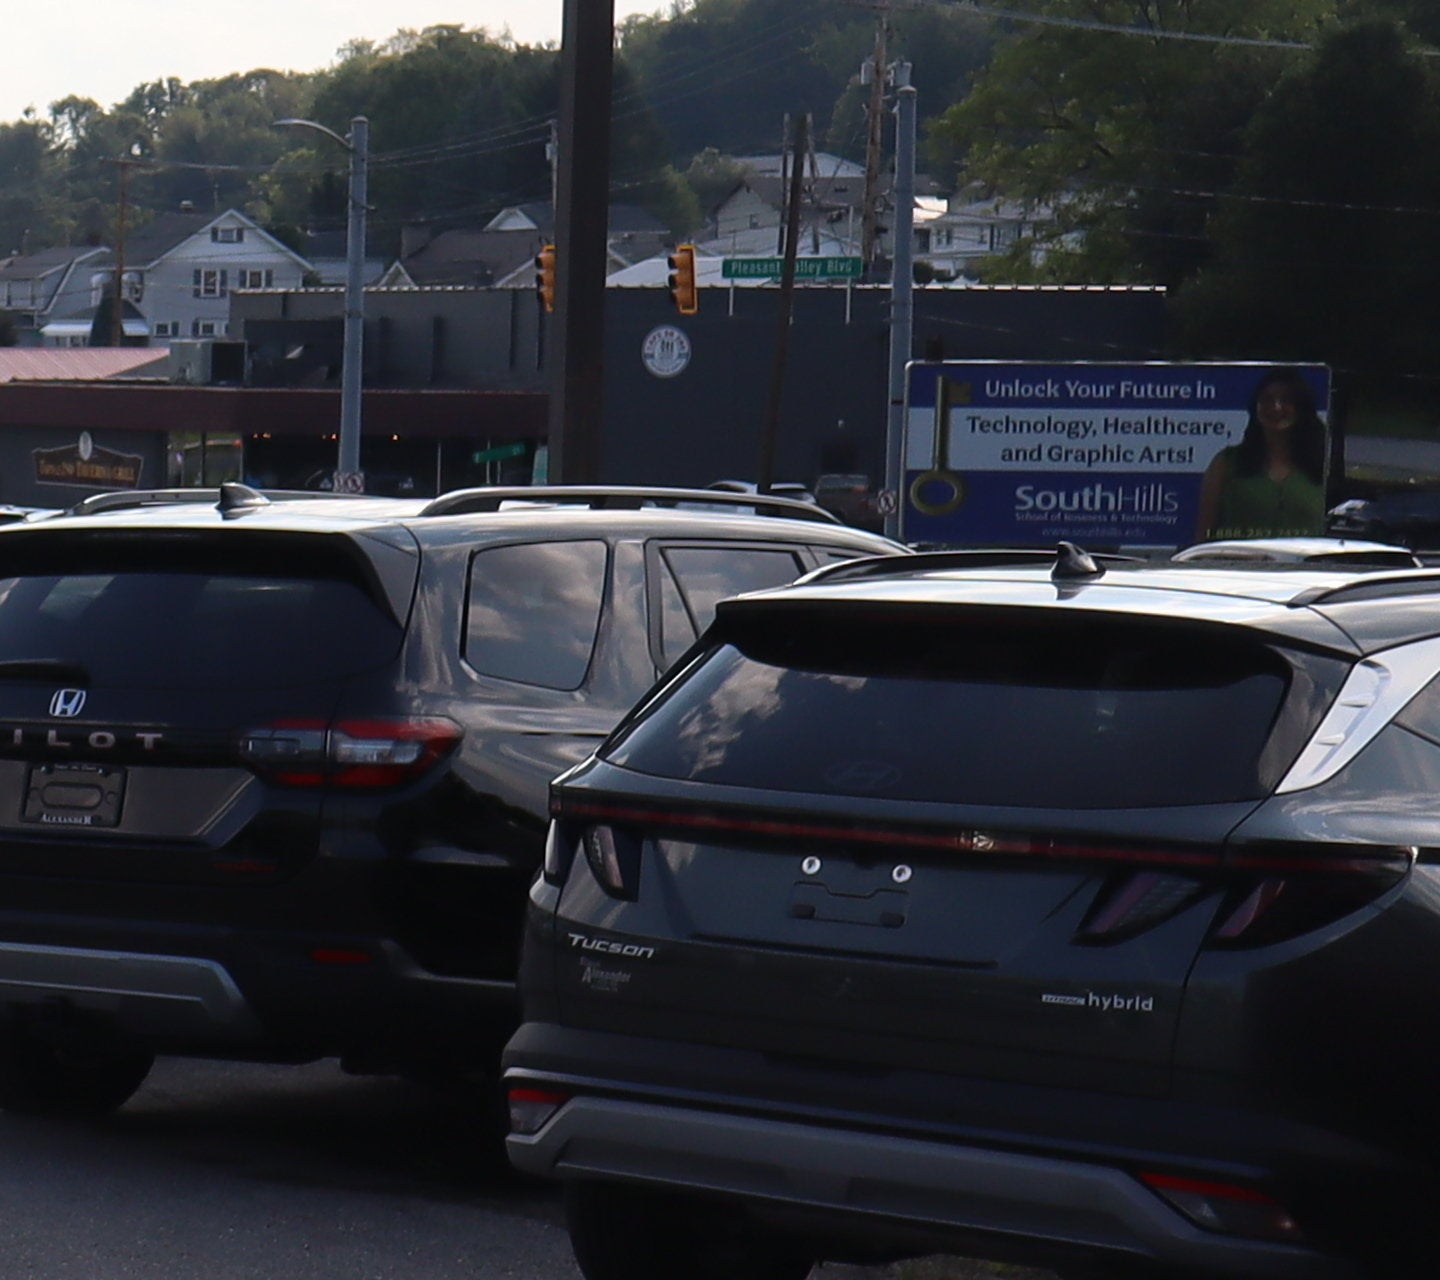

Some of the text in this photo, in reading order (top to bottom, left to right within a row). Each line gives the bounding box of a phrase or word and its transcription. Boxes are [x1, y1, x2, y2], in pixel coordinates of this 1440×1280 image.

[794, 261, 822, 275] alley
[827, 260, 852, 272] Blvd
[985, 378, 1216, 400] Unlock Your Future in
[966, 415, 1232, 440] Technology, Healthcare,
[1001, 444, 1194, 468] and Graphic Arts!
[1087, 991, 1154, 1012] hybrid
